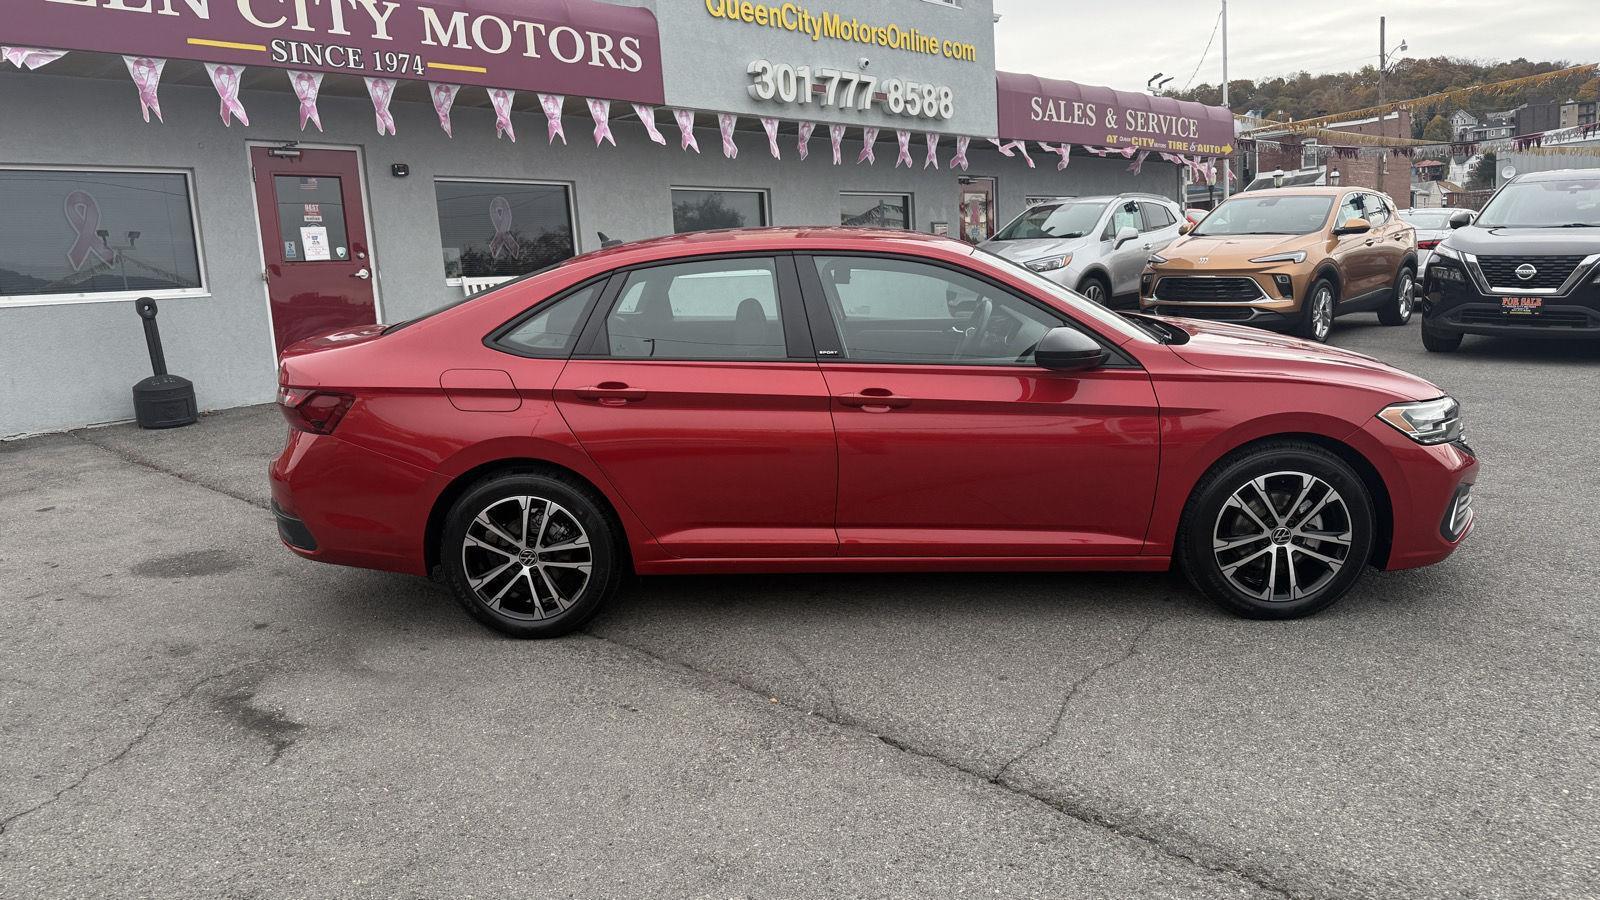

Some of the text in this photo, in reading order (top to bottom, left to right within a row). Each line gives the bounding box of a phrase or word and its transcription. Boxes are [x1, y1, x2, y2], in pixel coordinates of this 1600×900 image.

[237, 0, 643, 73] CITY MOTORS
[270, 39, 425, 75] SINCE 1974
[747, 58, 955, 120] 301-777-8588
[1031, 96, 1199, 138] SALES & SERVICE
[1106, 134, 1118, 144] AT
[1131, 136, 1155, 148] CITY
[1168, 140, 1188, 151] TIRE
[1189, 142, 1197, 152] &
[1197, 143, 1221, 154] AUTO
